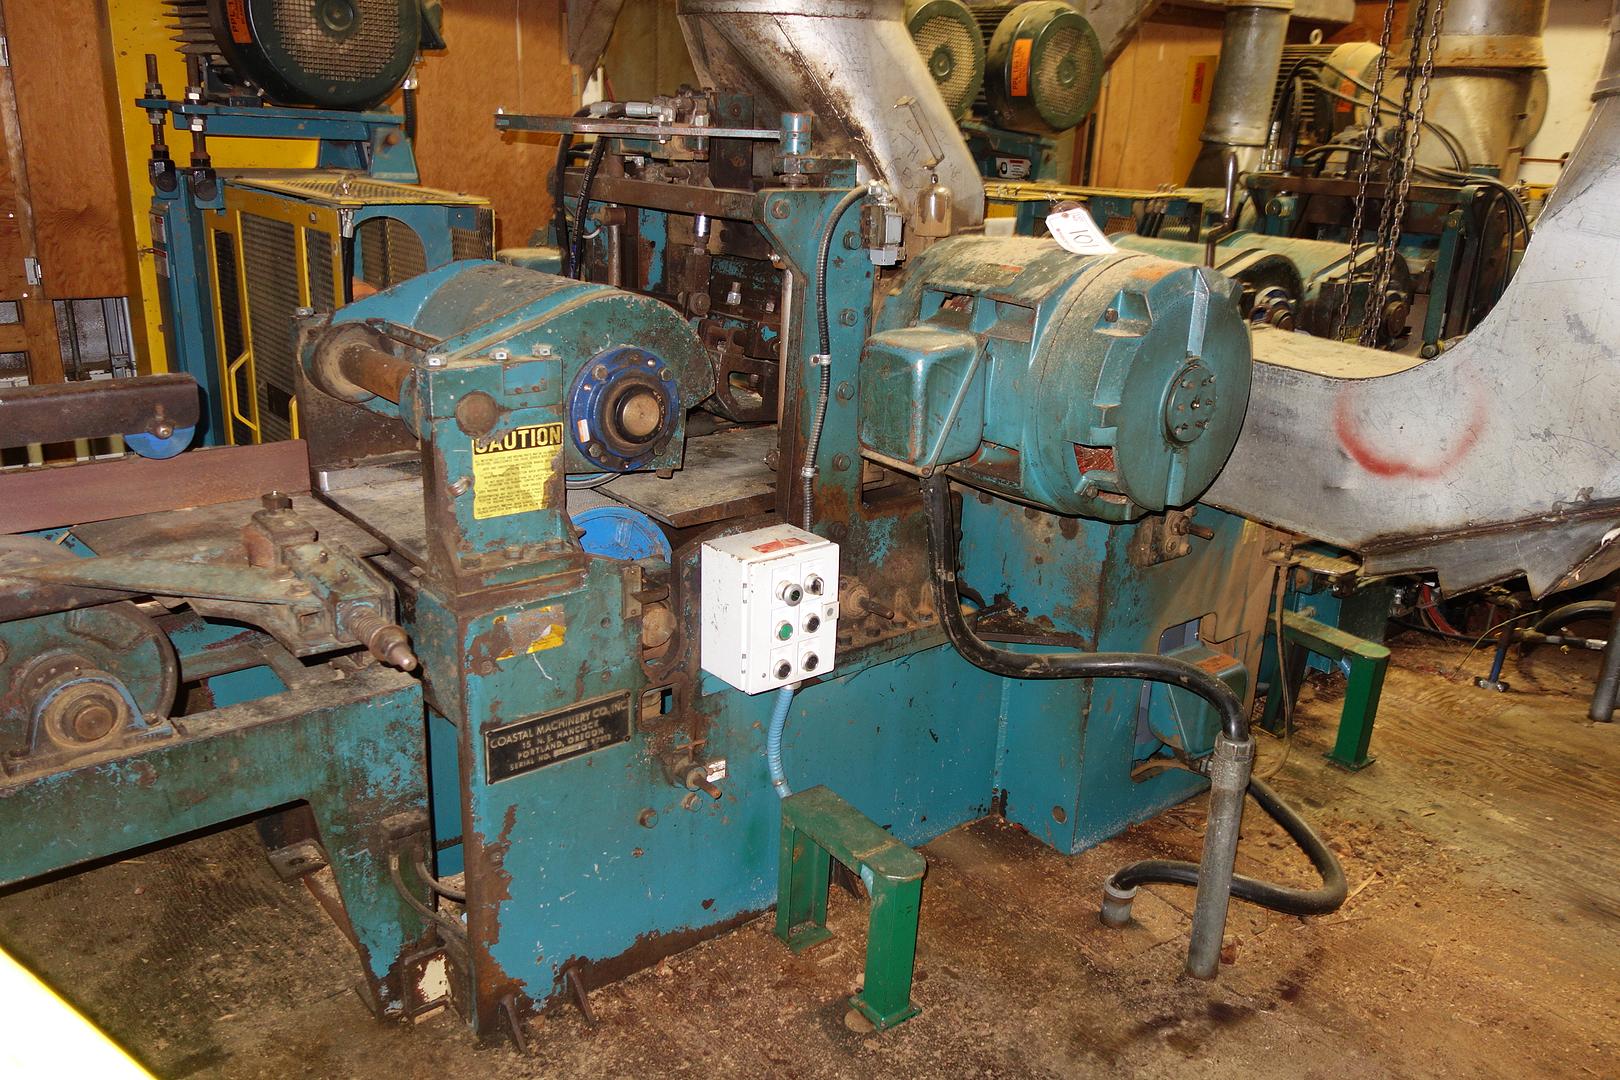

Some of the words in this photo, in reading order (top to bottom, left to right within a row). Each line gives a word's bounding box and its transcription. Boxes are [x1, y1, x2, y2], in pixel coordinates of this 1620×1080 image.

[475, 426, 561, 454] CAUTION
[490, 729, 533, 749] COASTAL
[536, 711, 592, 736] MACHINERY
[517, 741, 565, 760] PORTLAND,
[568, 728, 605, 744] OREGON
[522, 741, 532, 749] 15
[556, 720, 600, 739] HANCOCK
[509, 758, 535, 772] SERIAL
[538, 752, 551, 761] NO.
